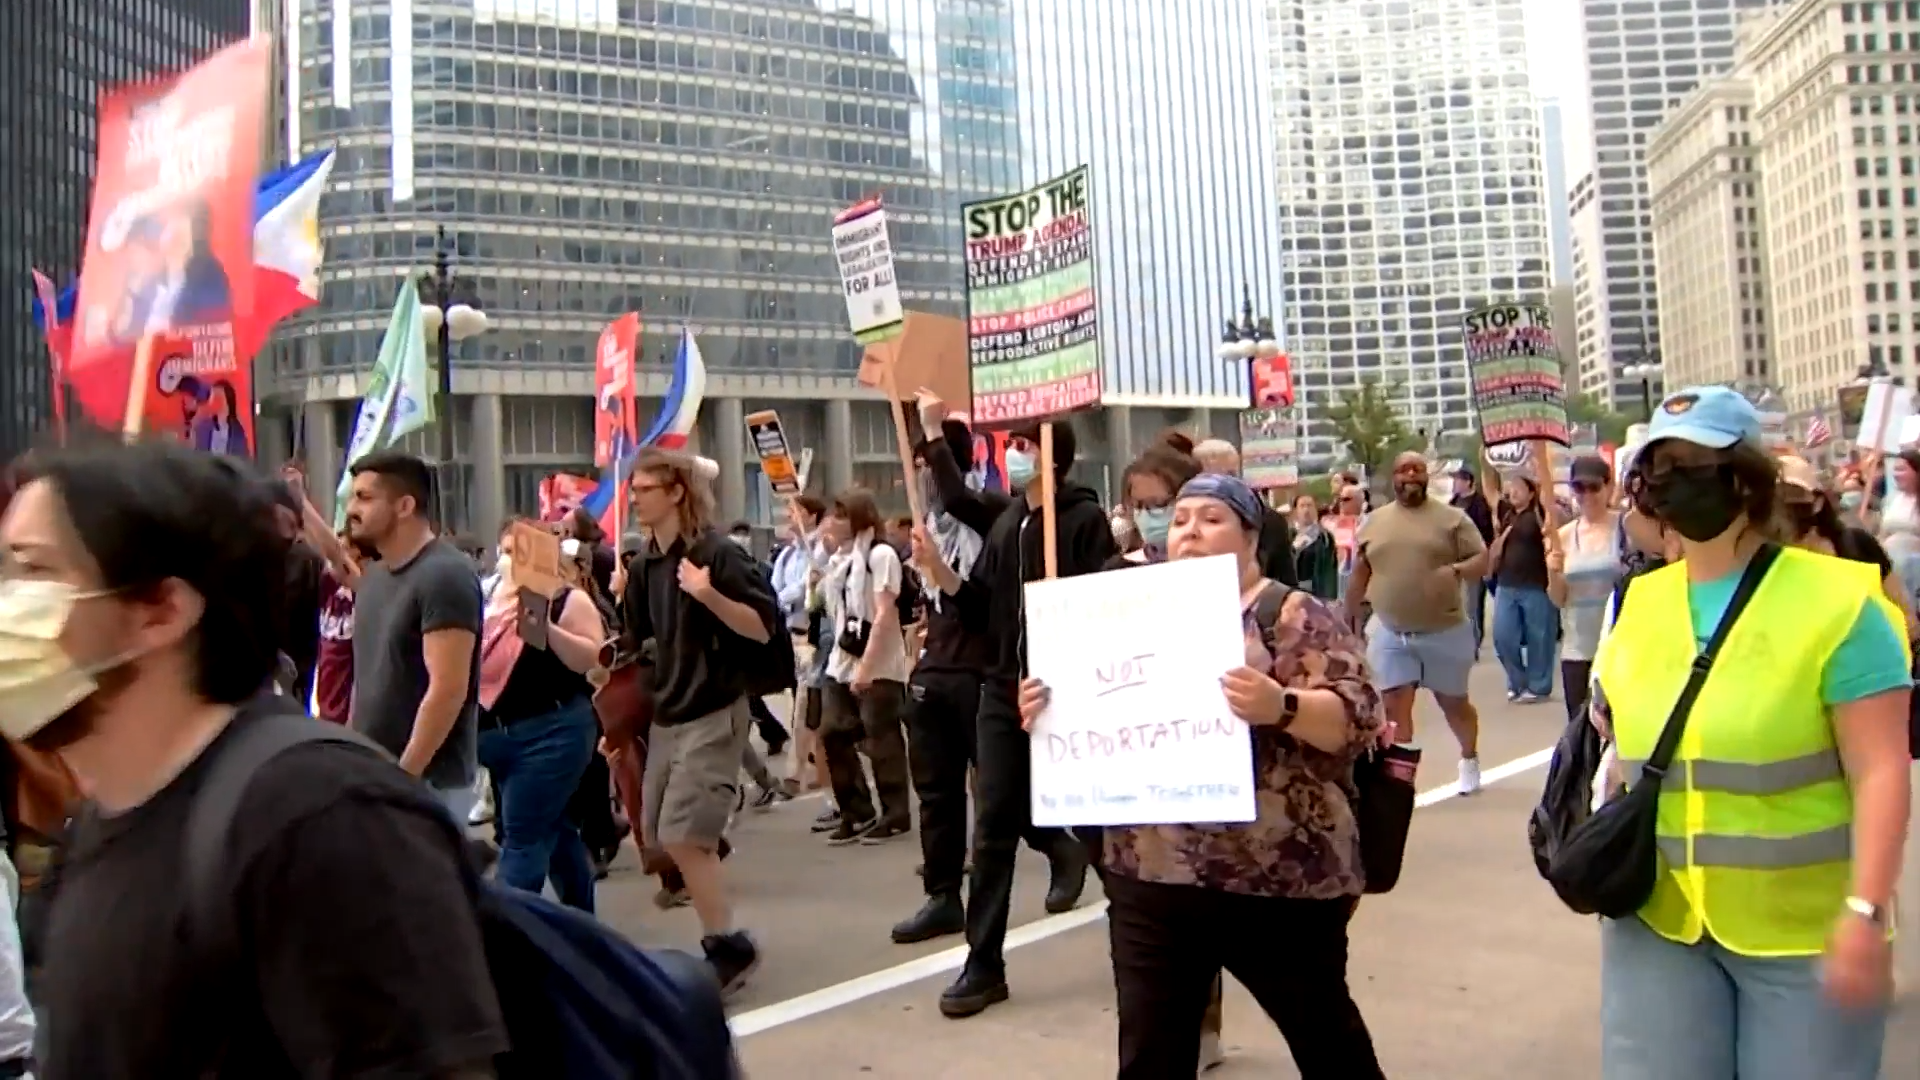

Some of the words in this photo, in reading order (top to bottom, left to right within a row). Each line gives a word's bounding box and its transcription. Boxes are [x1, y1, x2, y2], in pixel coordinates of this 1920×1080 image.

[969, 195, 1040, 239] STOP
[1045, 174, 1085, 220] THE
[968, 232, 1027, 260] TRUMP
[968, 253, 1028, 277] DEFEND
[969, 260, 1049, 288] IMMIGRANT
[846, 276, 870, 297] FOR
[971, 316, 1008, 335] STOP
[1014, 304, 1055, 325] POLICE
[1466, 306, 1519, 335] STOP
[971, 331, 1023, 350] DEFEND
[971, 337, 1060, 364] REPRODUCTIVE
[974, 391, 1027, 408] DEFEND
[1096, 653, 1156, 683] NOT
[1048, 718, 1235, 764] DEPORTATION
